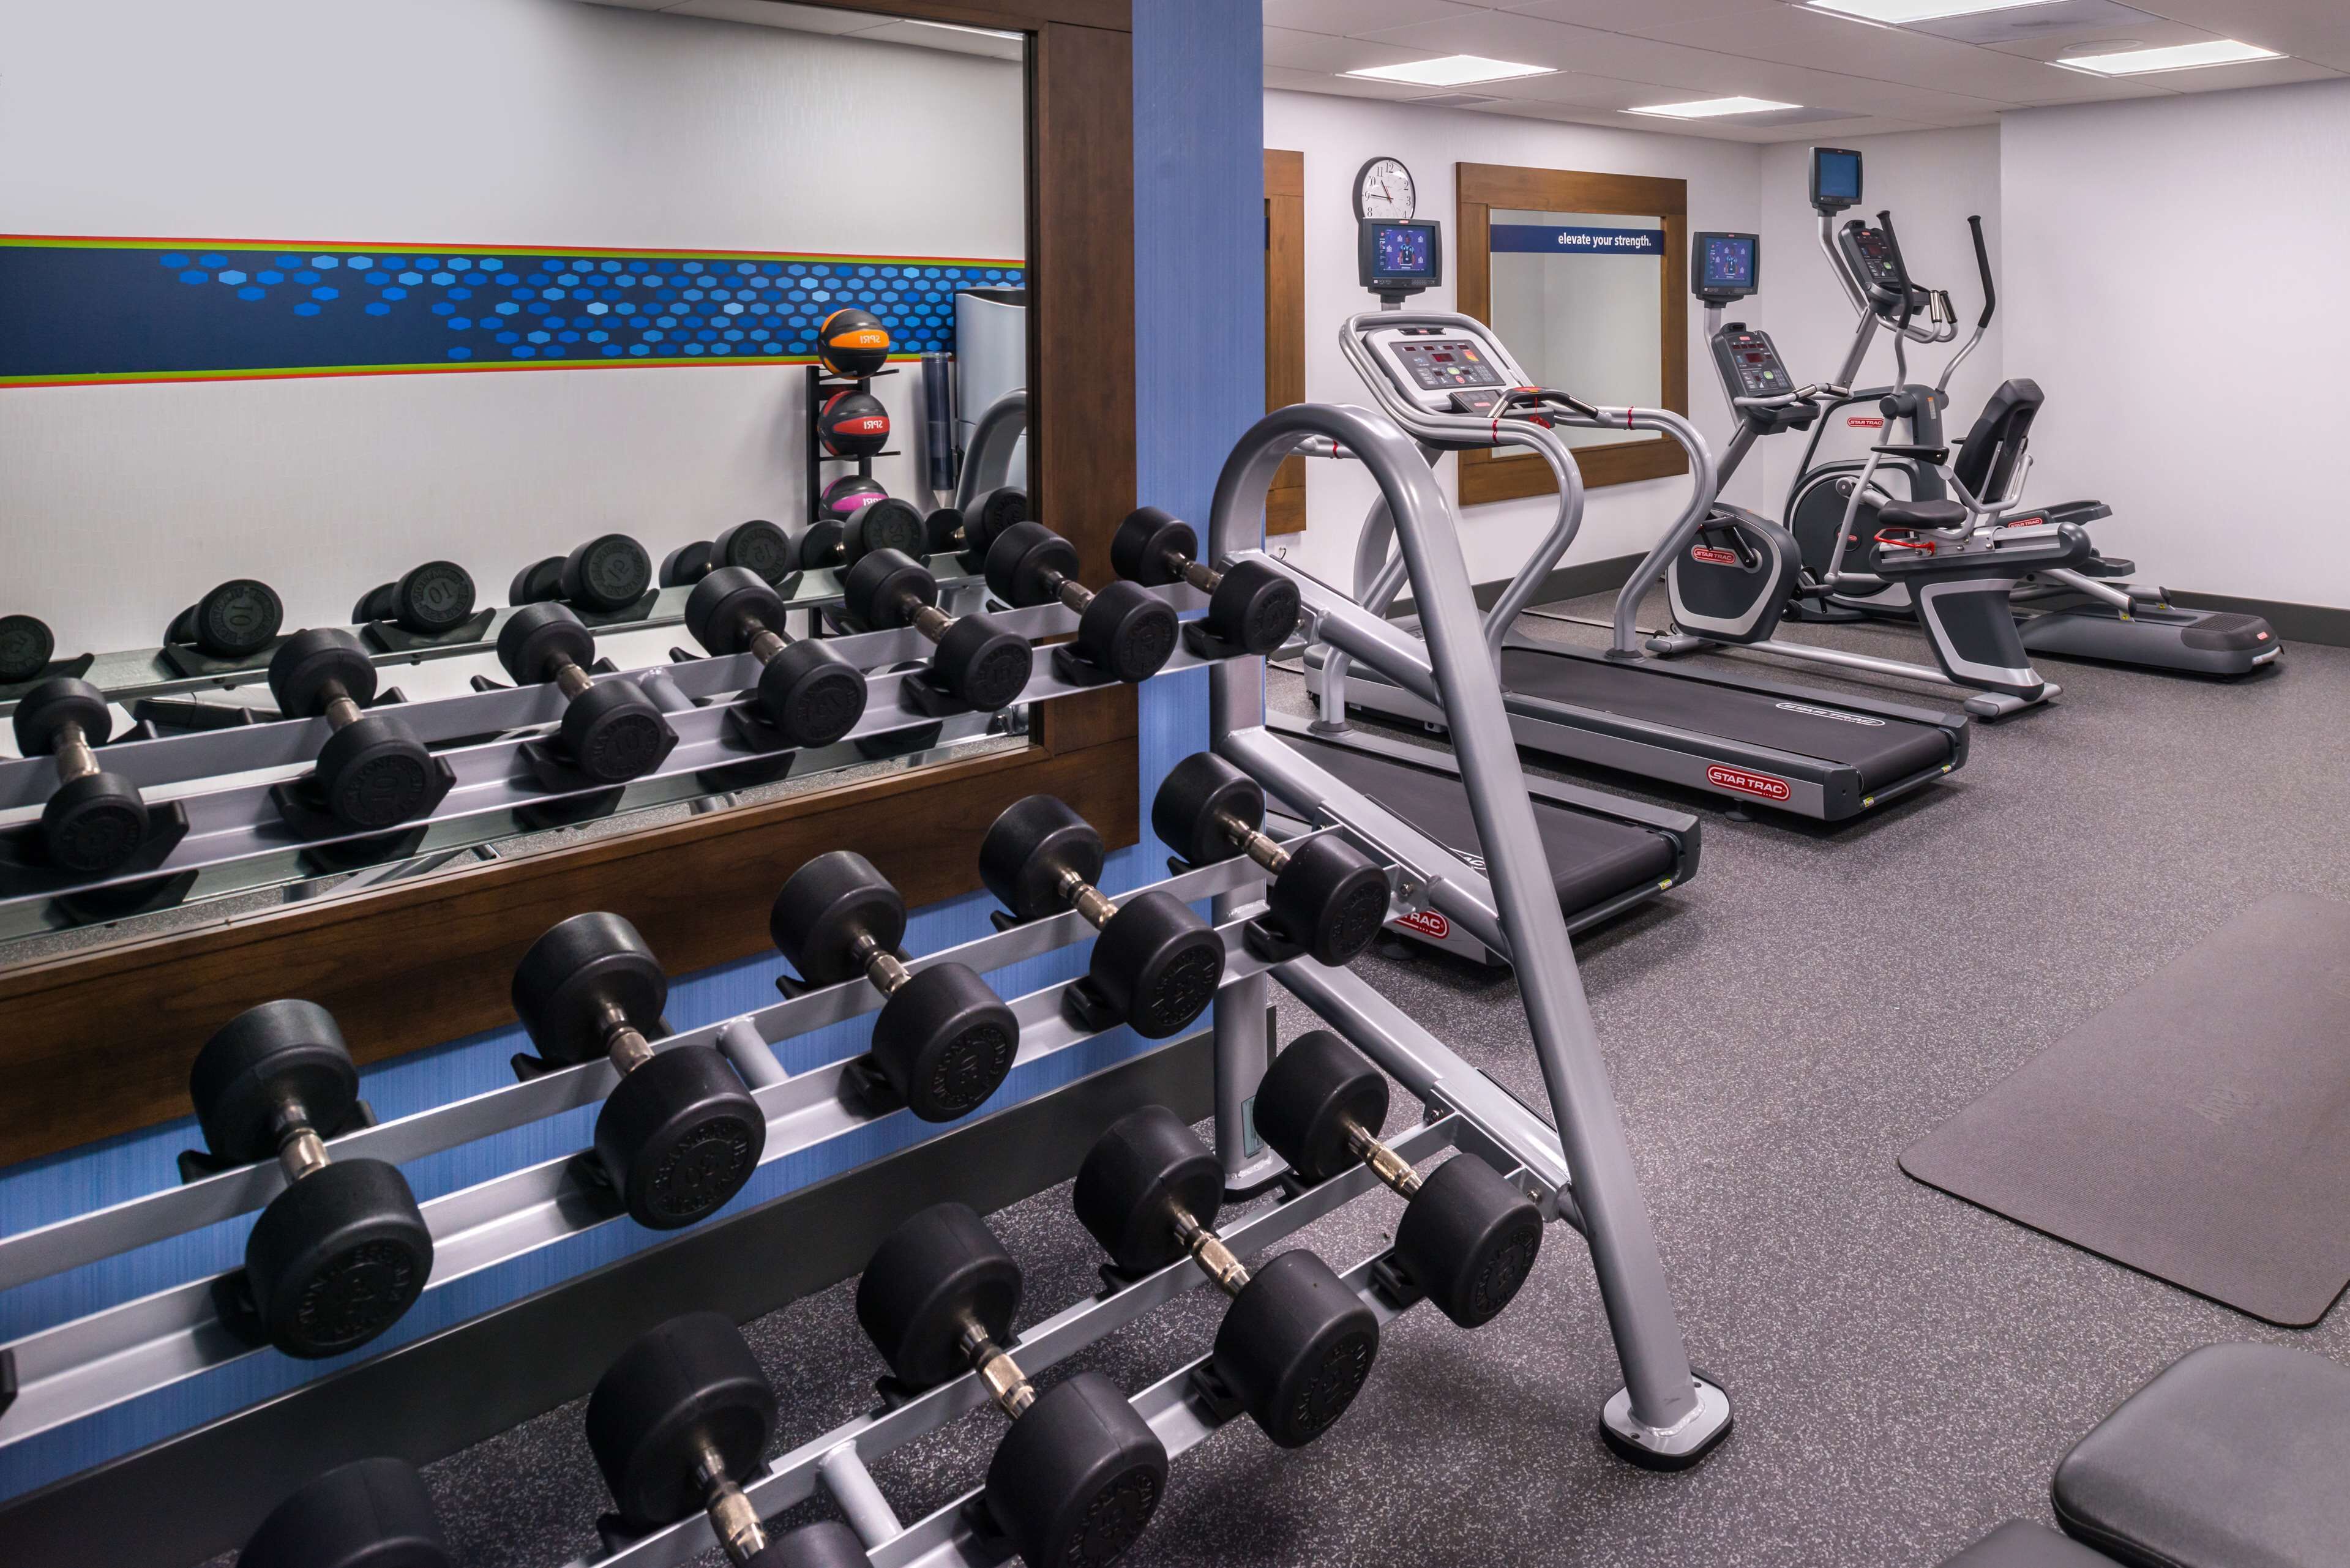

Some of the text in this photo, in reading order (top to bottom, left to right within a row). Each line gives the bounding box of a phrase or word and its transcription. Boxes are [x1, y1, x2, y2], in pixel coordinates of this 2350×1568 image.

[1377, 166, 1383, 177] 11
[1386, 162, 1394, 173] 12
[1404, 180, 1409, 191] 2
[1364, 191, 1371, 201] 9
[1405, 196, 1411, 206] 3
[1367, 207, 1372, 217] 8
[1558, 232, 1652, 249] elevate your strength.
[1781, 704, 1876, 724] STAR TRAC
[1713, 772, 1783, 794] STAR TRAC
[1404, 912, 1441, 930] RAC
